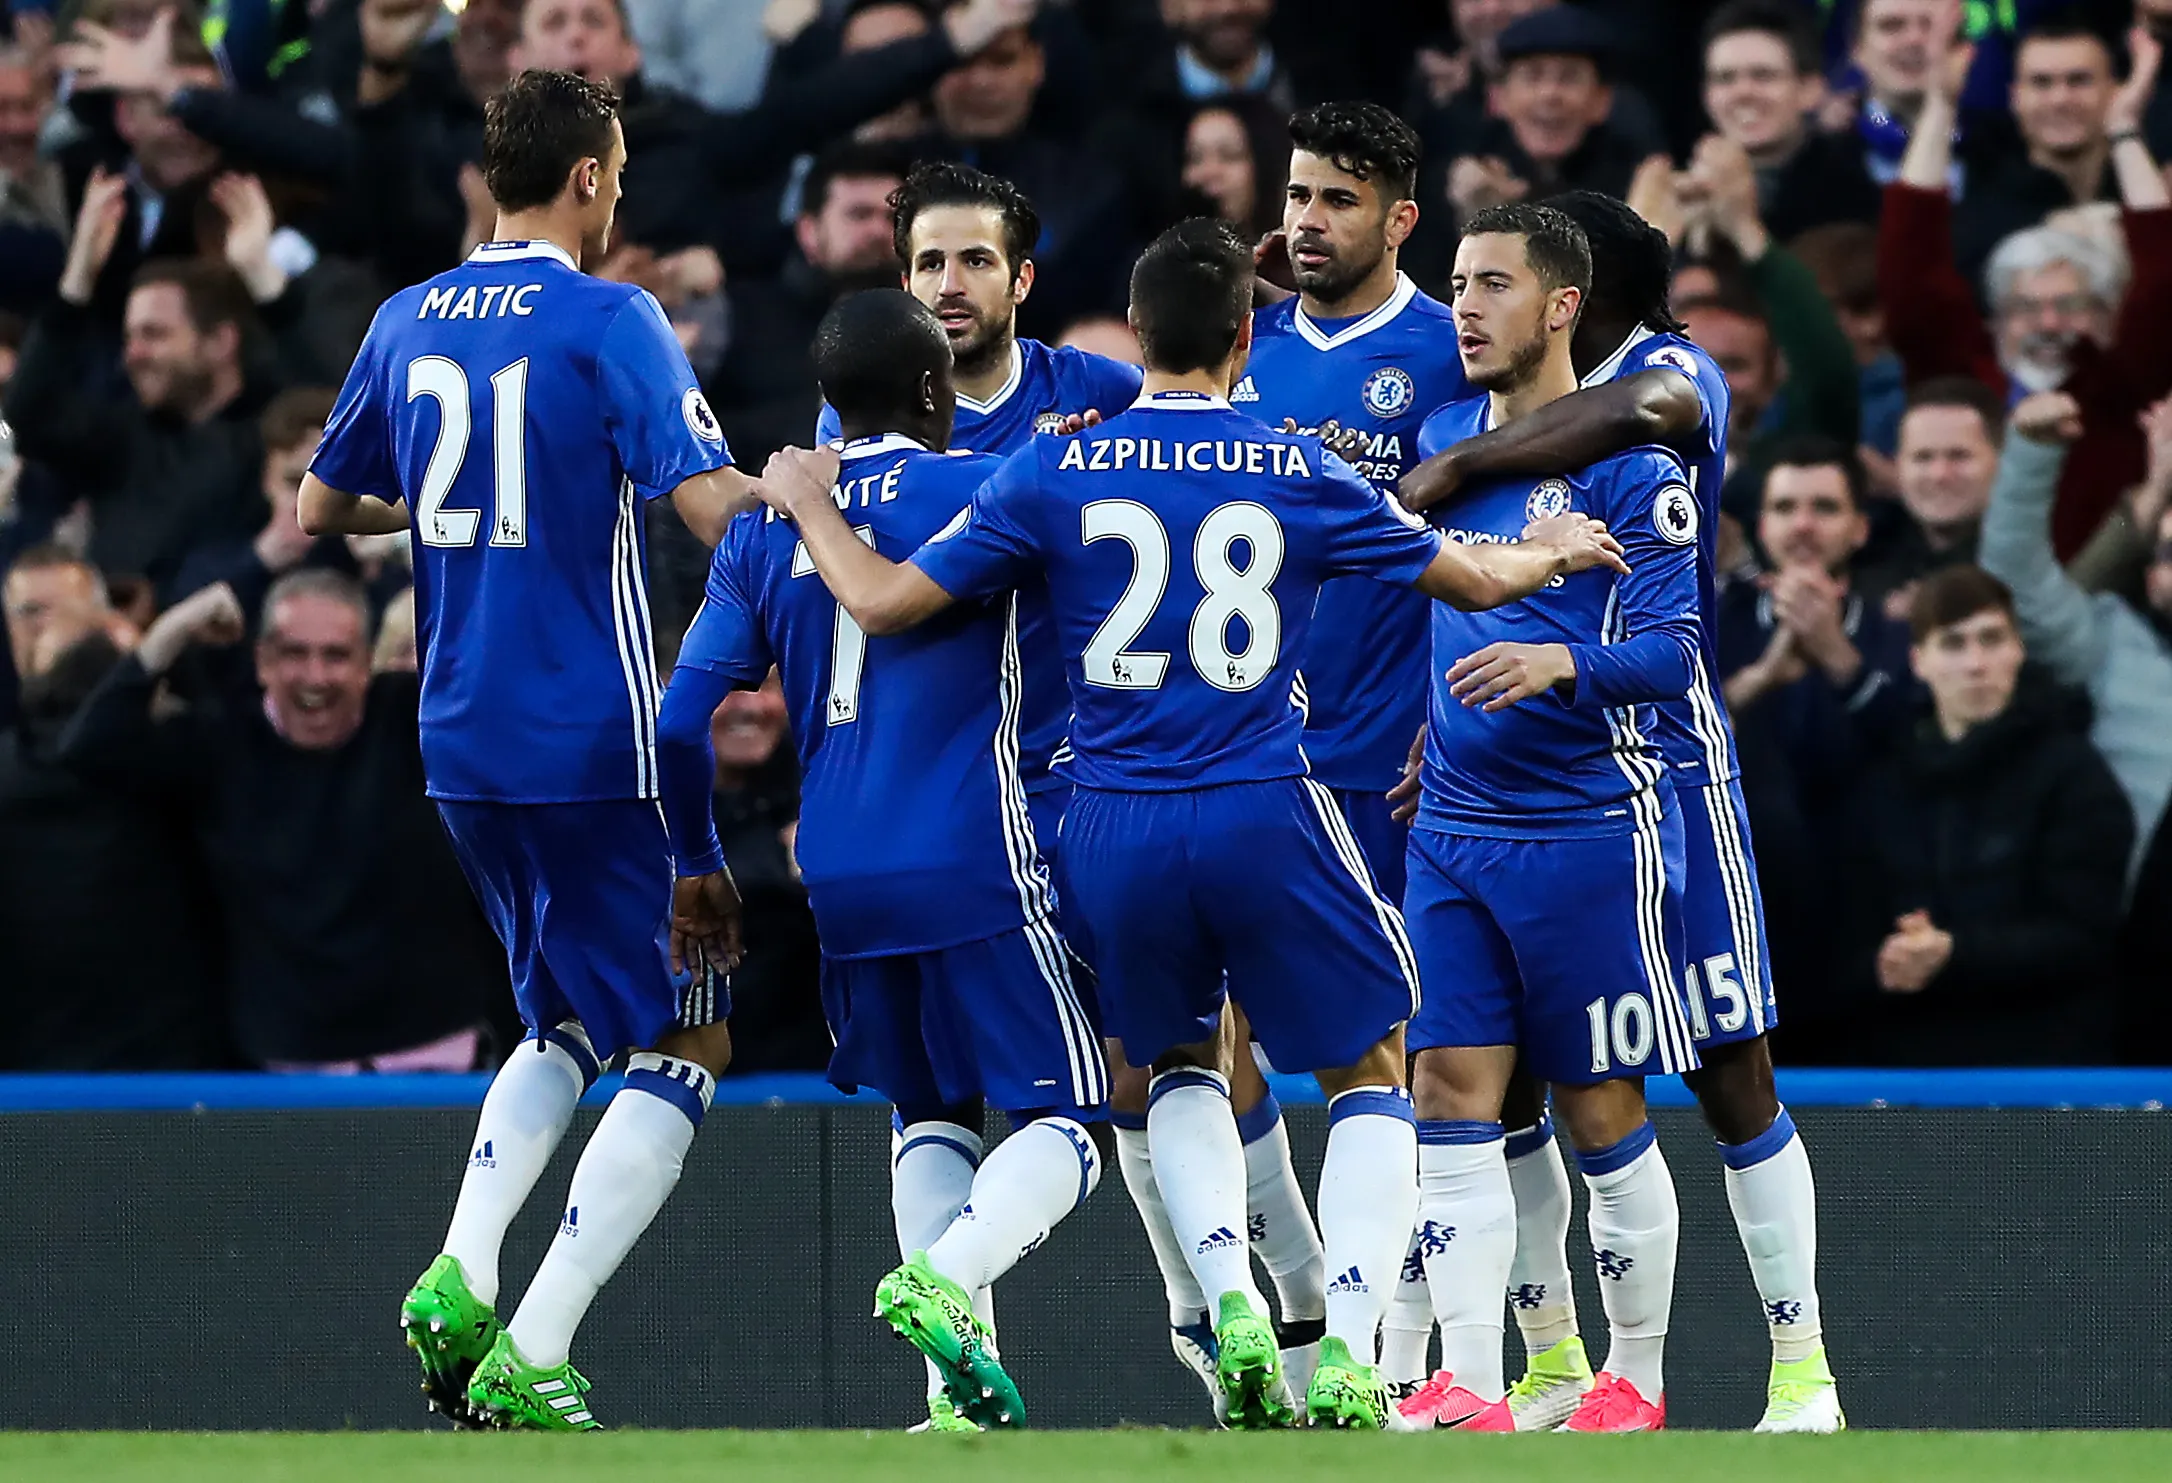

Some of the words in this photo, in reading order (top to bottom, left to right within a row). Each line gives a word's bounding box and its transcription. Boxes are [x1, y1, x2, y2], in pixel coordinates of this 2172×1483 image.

[417, 283, 543, 320] MATIC
[407, 355, 529, 548] 21
[1058, 438, 1311, 478] AZPILICUETA
[1080, 499, 1285, 692] 28
[1685, 952, 1748, 1041] 15
[1586, 992, 1654, 1073] 10
[1197, 1239, 1243, 1255] adidas
[942, 1299, 977, 1358] adidas
